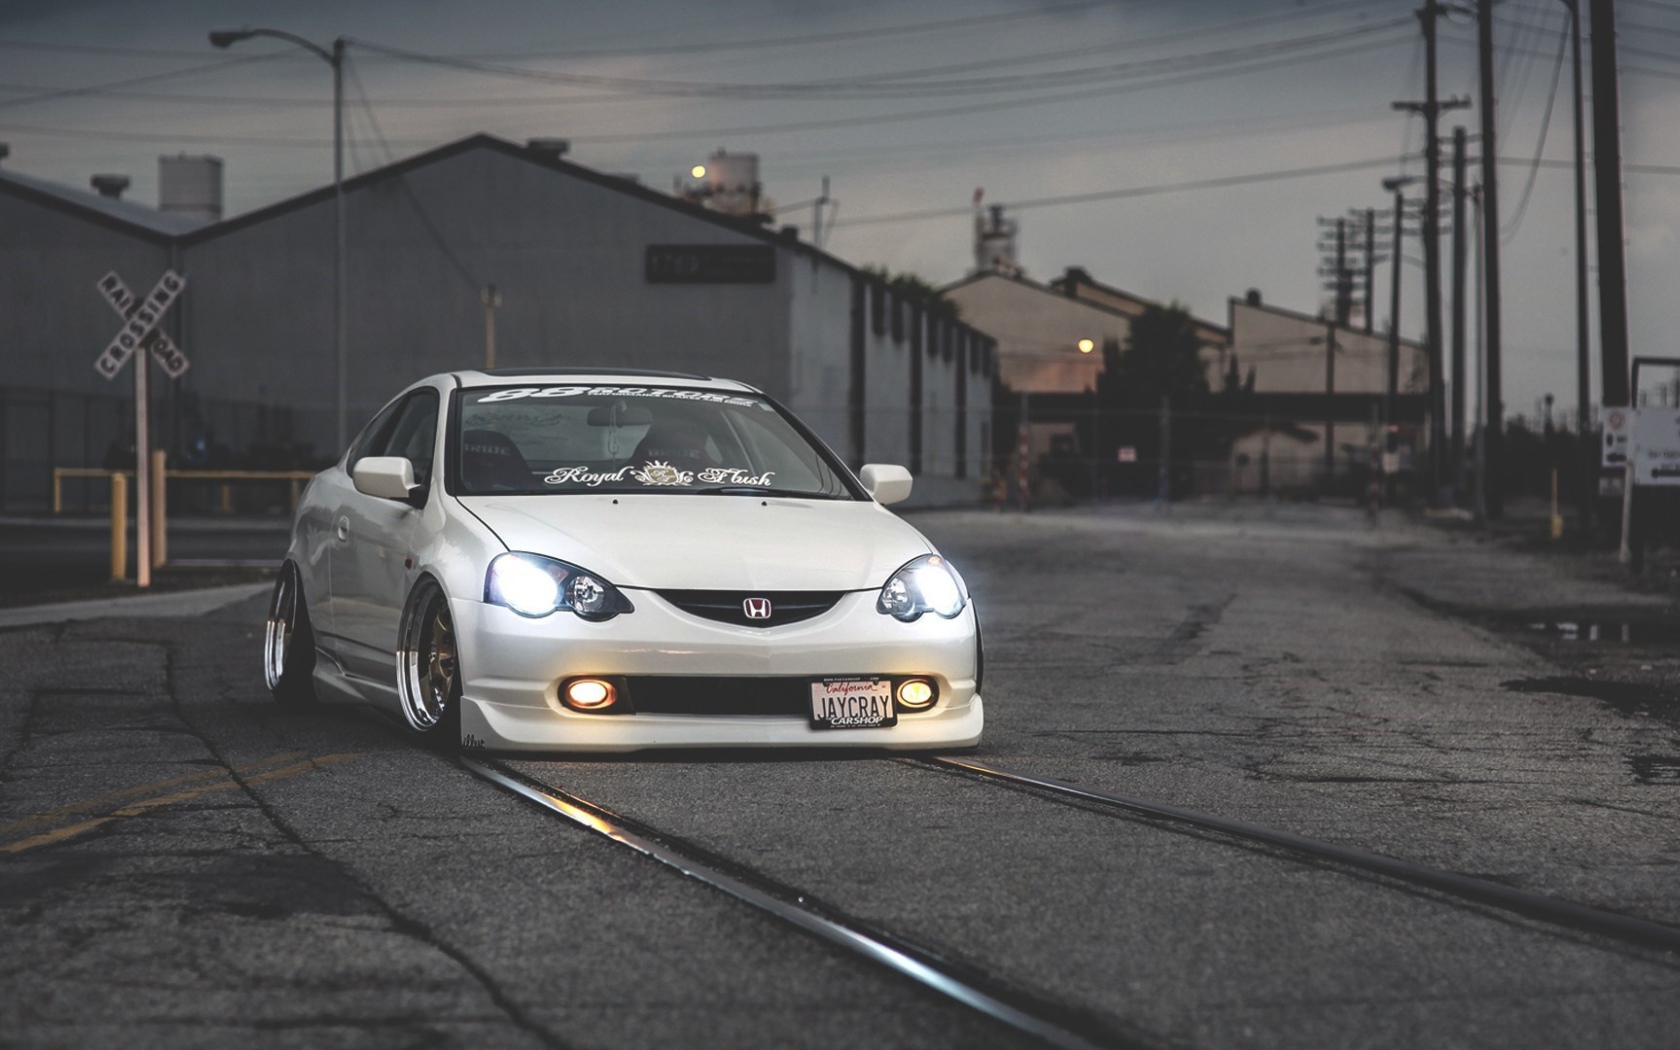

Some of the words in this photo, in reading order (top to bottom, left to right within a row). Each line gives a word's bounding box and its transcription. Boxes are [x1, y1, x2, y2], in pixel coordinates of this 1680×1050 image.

[100, 275, 180, 374] CROSSING
[544, 465, 634, 487] Royal
[697, 467, 775, 487] Flush
[826, 681, 879, 696] California
[817, 695, 889, 719] JAYCRAY
[831, 715, 884, 726] CARSHOP
